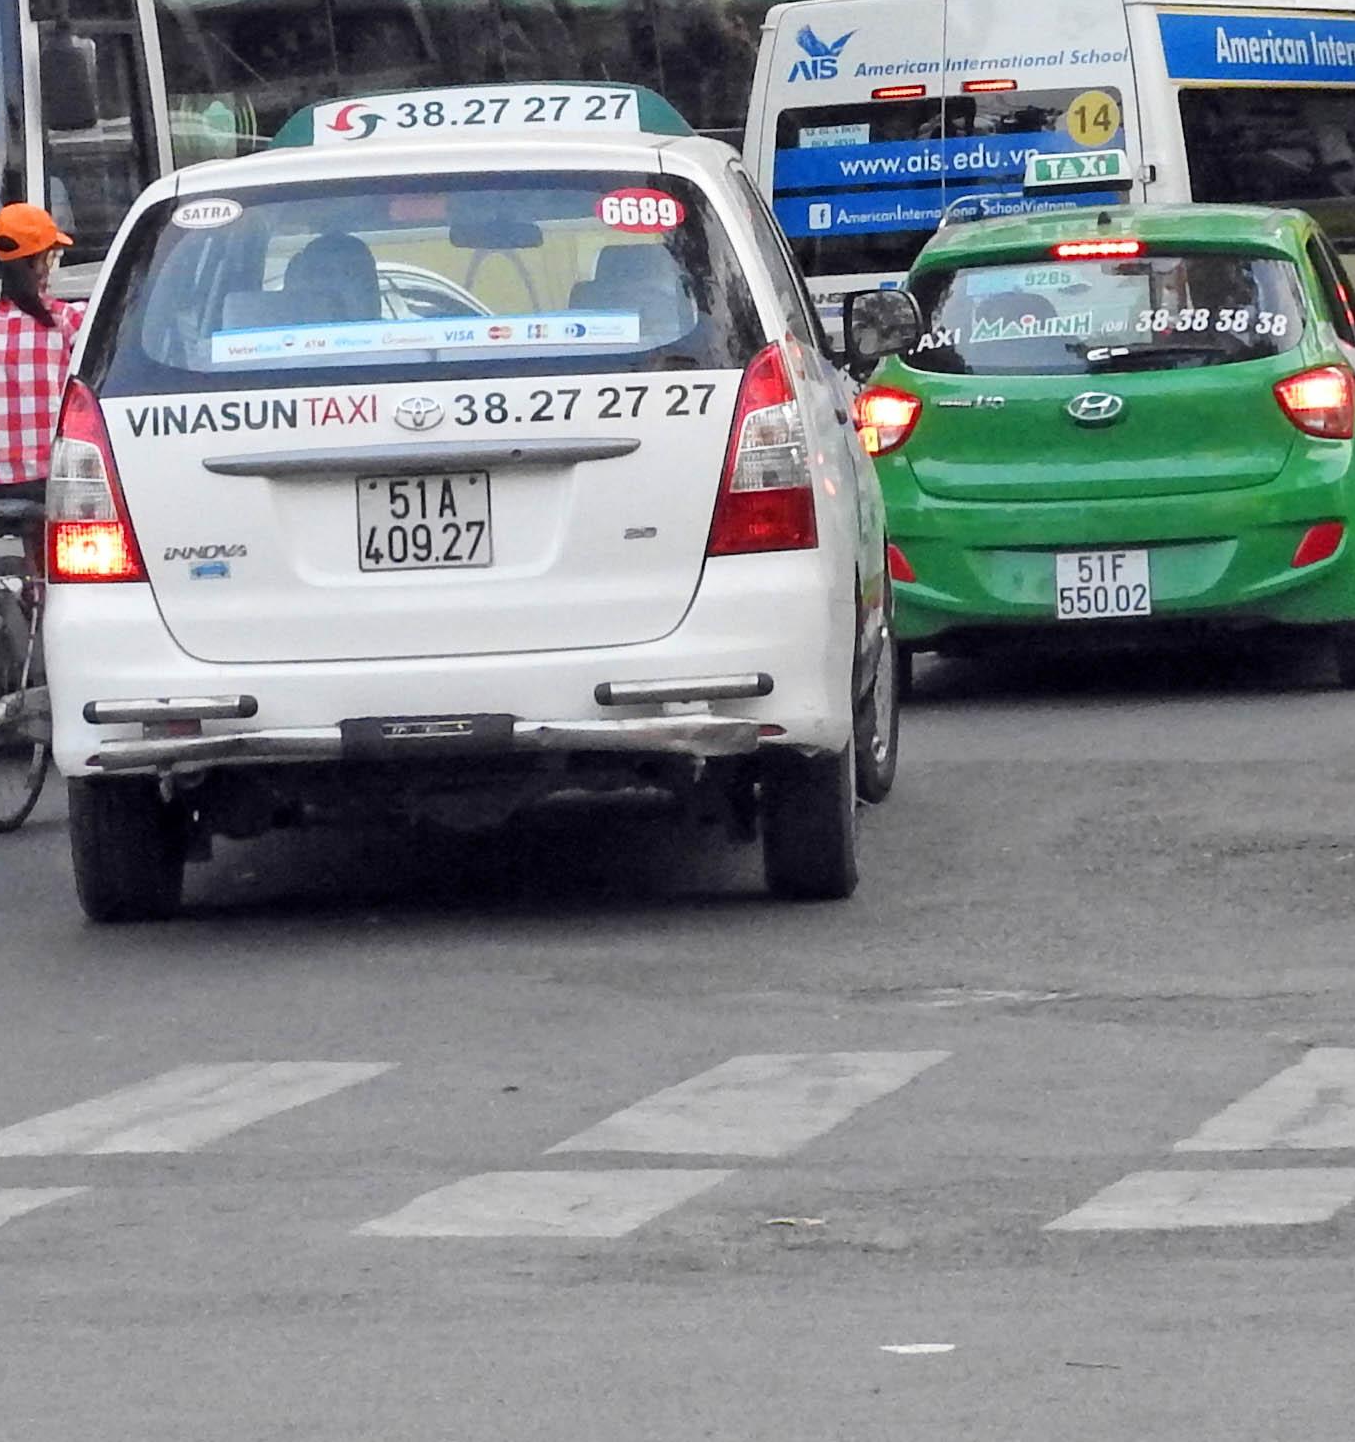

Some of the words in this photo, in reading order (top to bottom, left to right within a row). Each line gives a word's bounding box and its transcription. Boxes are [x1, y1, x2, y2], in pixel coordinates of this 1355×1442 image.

[1215, 25, 1306, 66] American
[787, 57, 839, 83] AIS
[853, 59, 941, 78] American
[944, 52, 1064, 74] International
[1070, 47, 1130, 66] School
[396, 97, 512, 130] 38.27
[523, 95, 570, 124] 27
[583, 93, 633, 122] 27
[1074, 103, 1112, 135] 14
[182, 204, 233, 222] SATRA
[601, 196, 678, 228] 6689
[444, 330, 475, 343] VISA
[908, 328, 961, 355] AXI
[1135, 309, 1169, 333] 38
[1175, 308, 1210, 333] 38
[1215, 308, 1248, 333] 38
[1255, 311, 1288, 338] 38
[452, 388, 583, 427] 38.27
[597, 386, 651, 420] 27
[664, 383, 718, 417] 27
[388, 478, 458, 520] 51A
[363, 520, 487, 564] 409.27
[1078, 554, 1125, 585] 51F
[1059, 584, 1149, 616] 550.02
